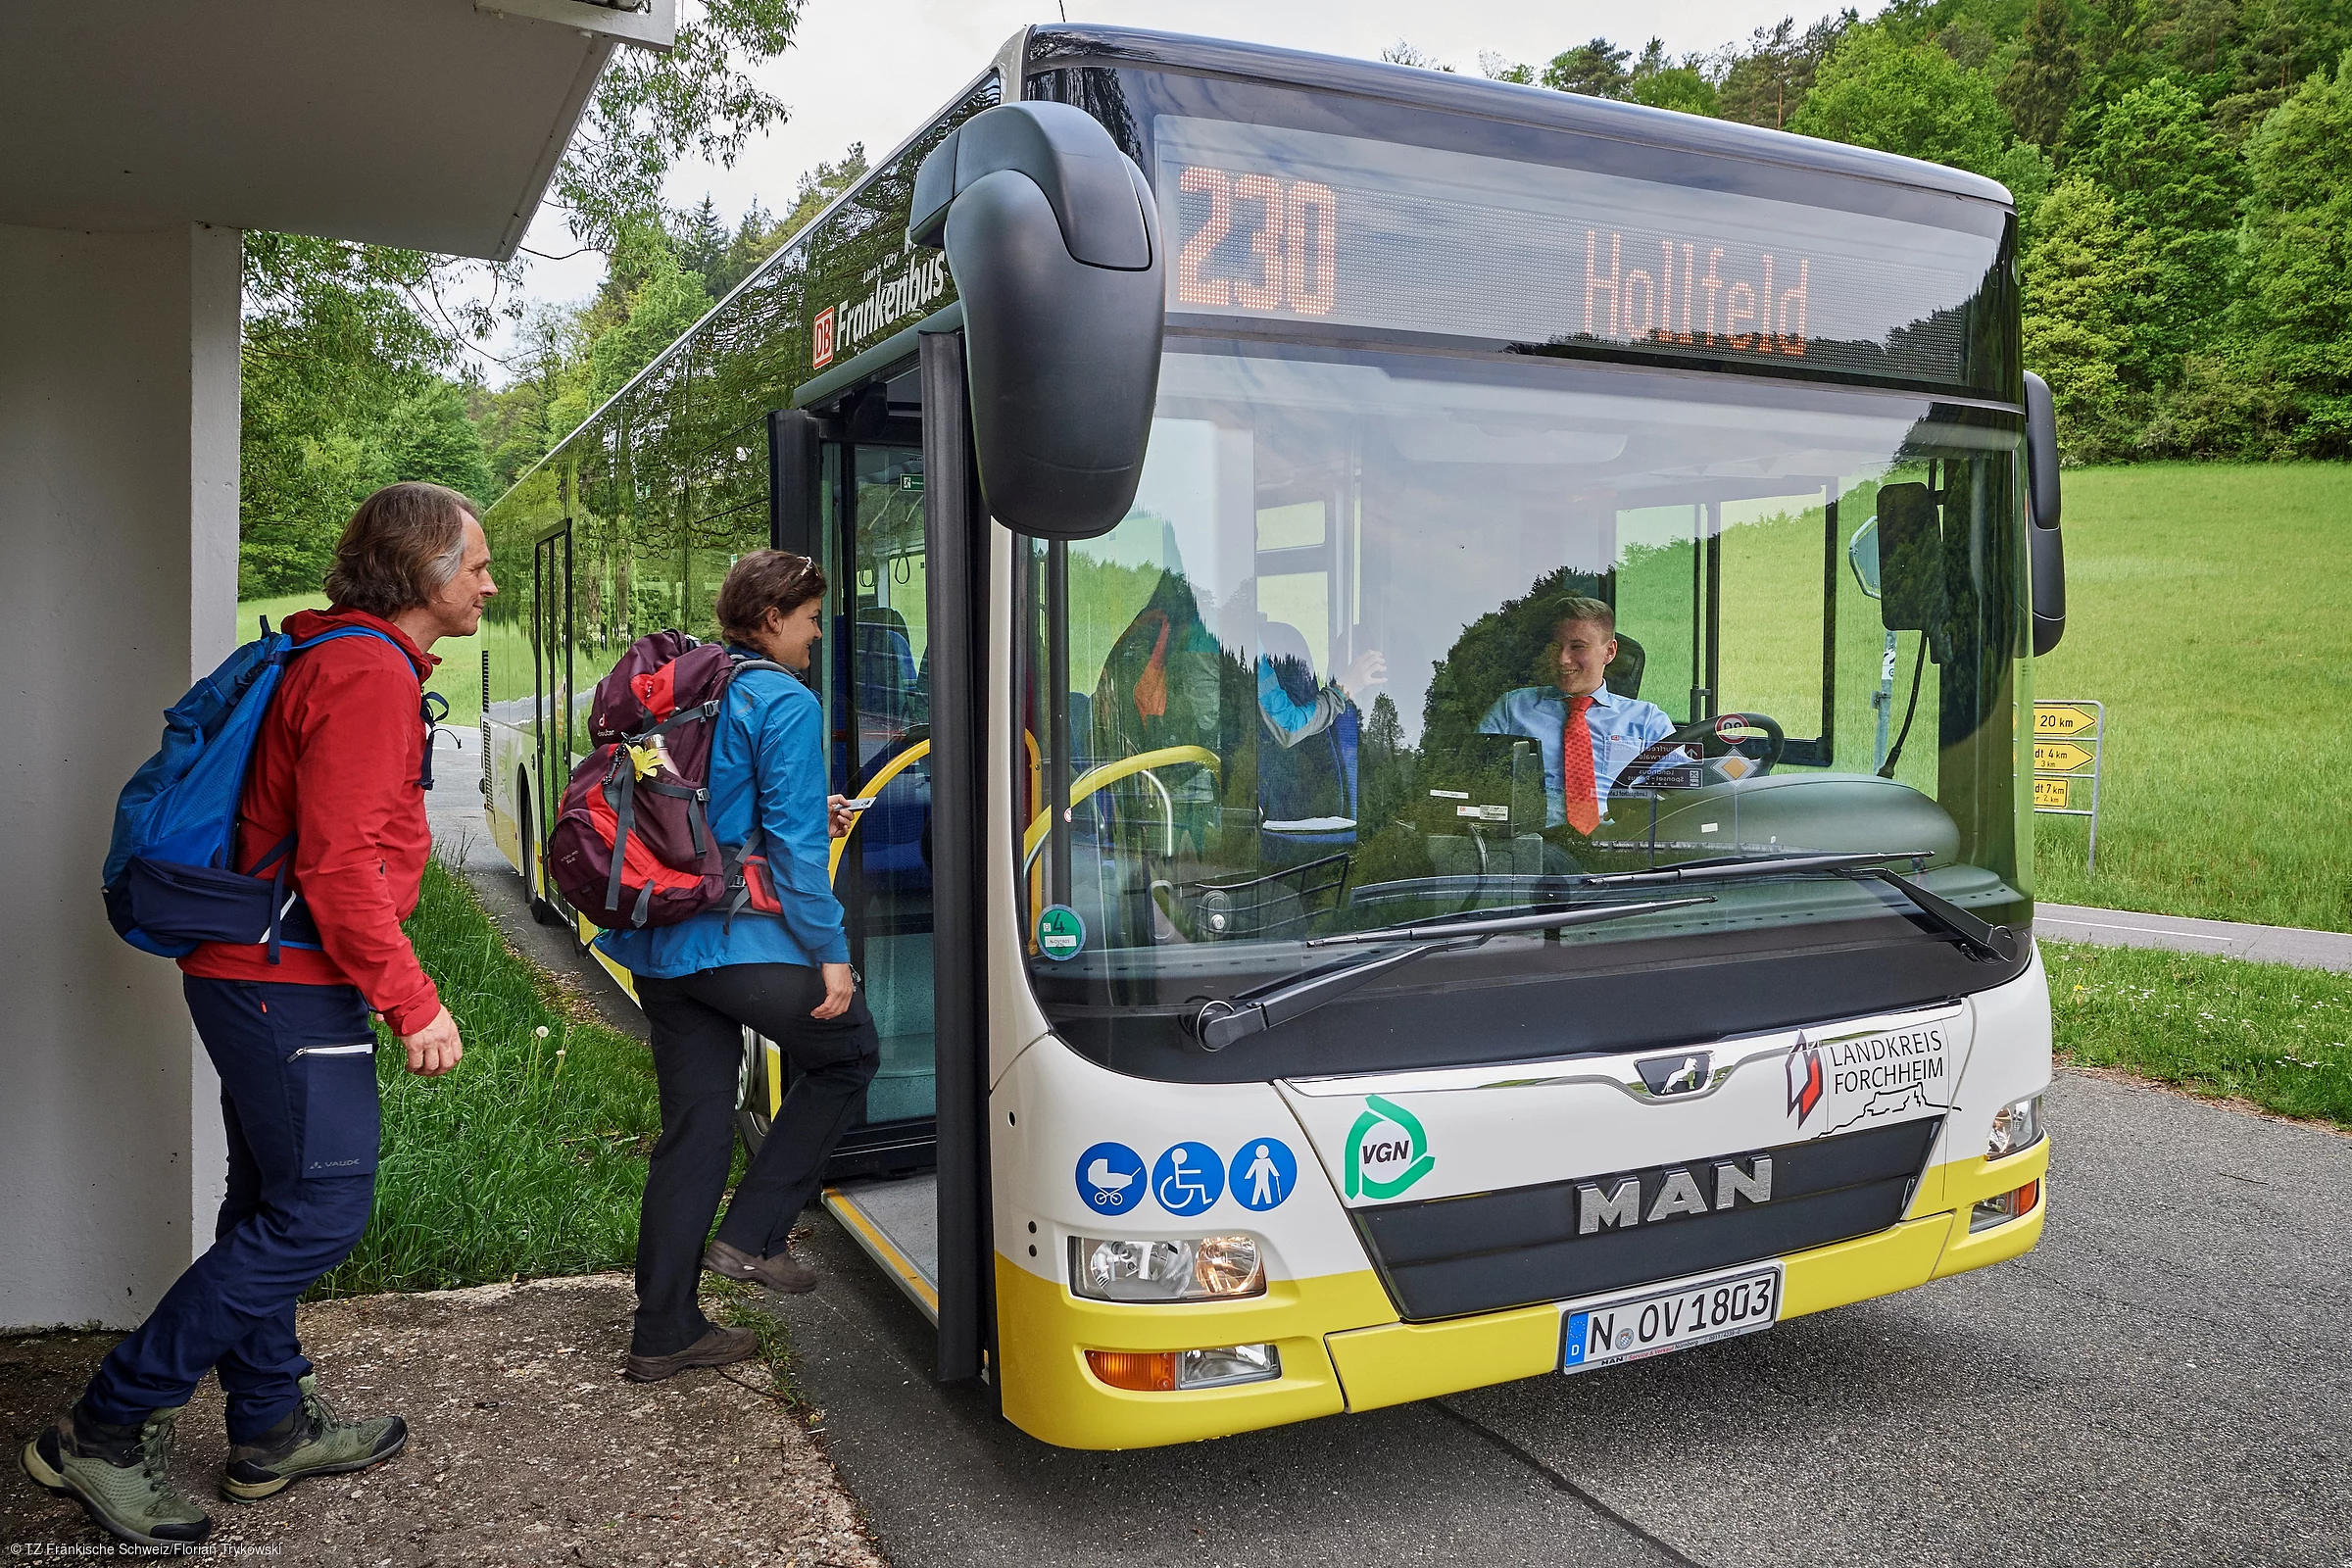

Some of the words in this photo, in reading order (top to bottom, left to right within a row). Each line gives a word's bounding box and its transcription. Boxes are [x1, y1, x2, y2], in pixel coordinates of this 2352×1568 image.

[1179, 165, 1336, 316] 230
[815, 318, 831, 360] DB
[836, 250, 946, 352] Frankenbus
[1586, 229, 1809, 357] Hollfeld
[2040, 715, 2056, 727] 20
[2059, 717, 2073, 727] km
[2048, 749, 2054, 759] 4
[2056, 751, 2068, 760] km
[2046, 784, 2052, 794] 7
[2053, 786, 2065, 795] km
[1053, 912, 1065, 934] 4
[1830, 1029, 1942, 1067] LANDKREIS
[1834, 1056, 1943, 1095] FORCHHEIM
[324, 1158, 361, 1167] VAUDE
[1362, 1140, 1410, 1165] VGN
[1574, 1152, 1773, 1235] MAN
[1589, 1312, 1615, 1354] N
[1571, 1345, 1580, 1356] D
[1601, 1356, 1624, 1366] MAN
